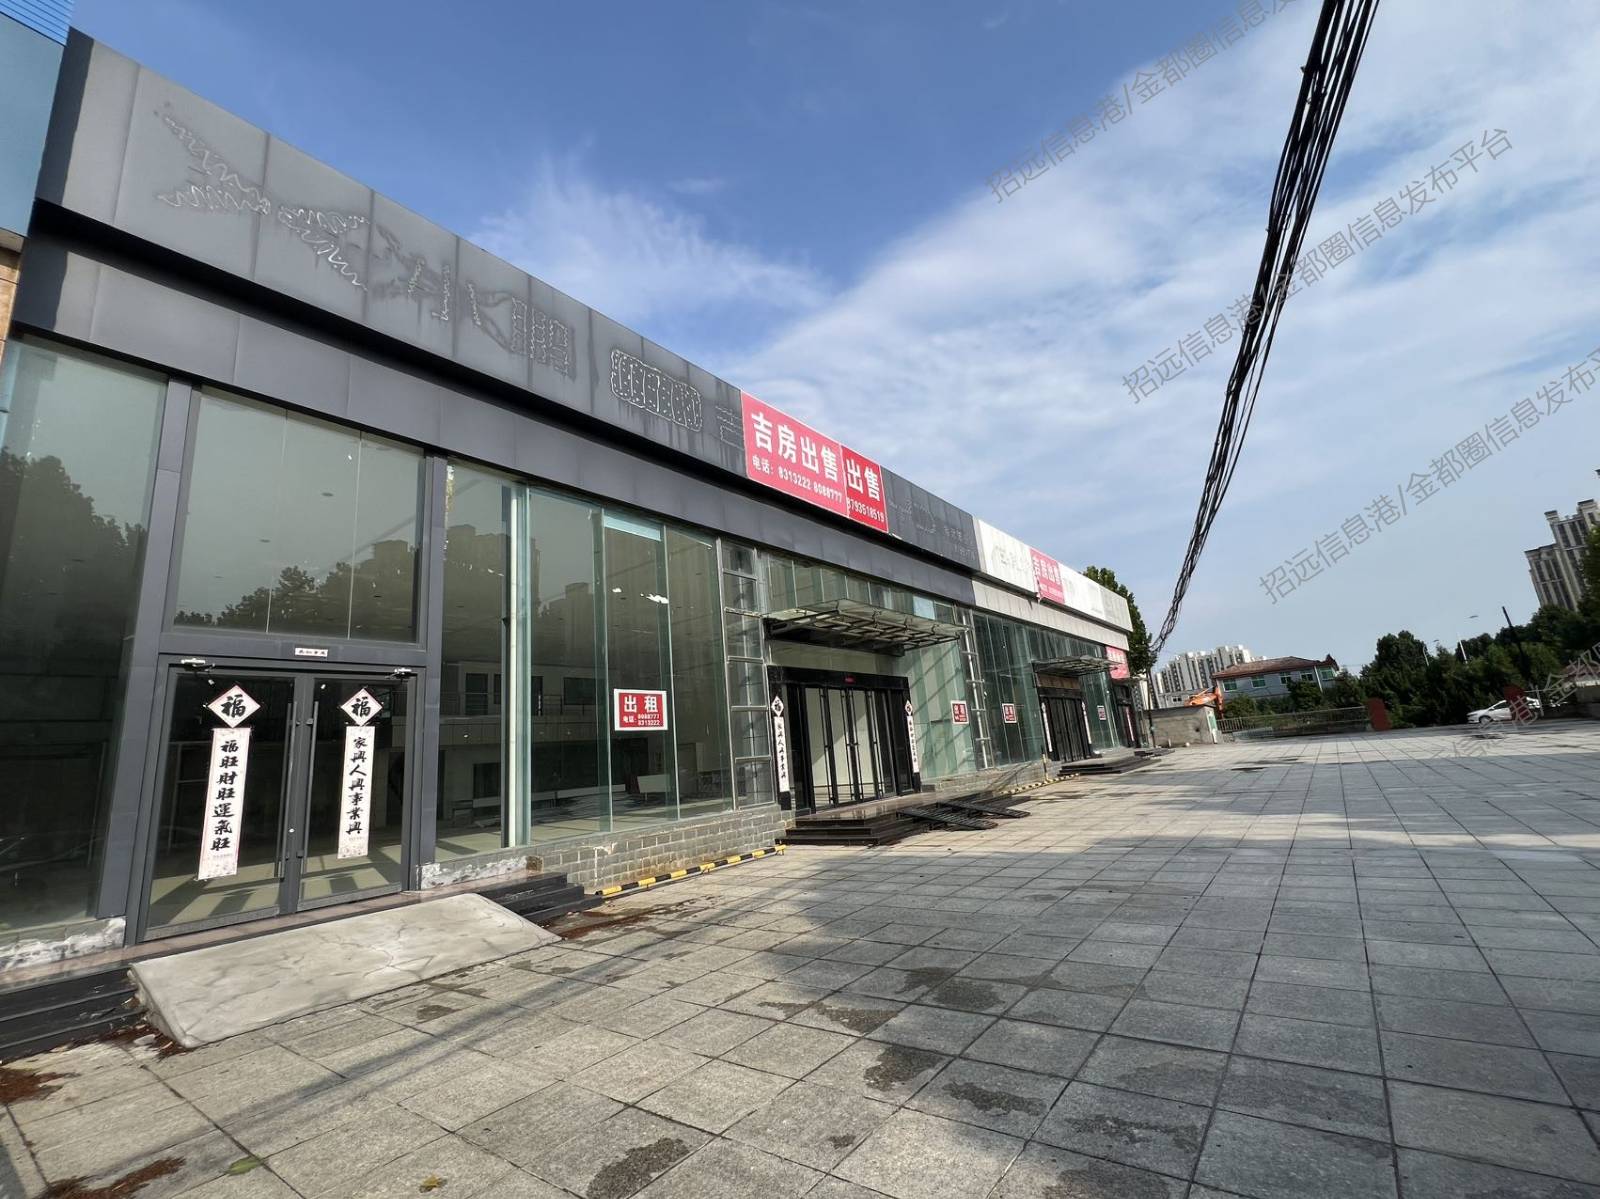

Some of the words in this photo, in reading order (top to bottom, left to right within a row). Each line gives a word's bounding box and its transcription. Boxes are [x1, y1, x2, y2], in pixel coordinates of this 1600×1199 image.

[751, 412, 838, 482] 吉房出售
[778, 466, 811, 490] 8313222
[846, 458, 881, 501] 出售
[220, 694, 247, 718] 福
[351, 697, 372, 717] 福
[624, 695, 658, 713] 出租
